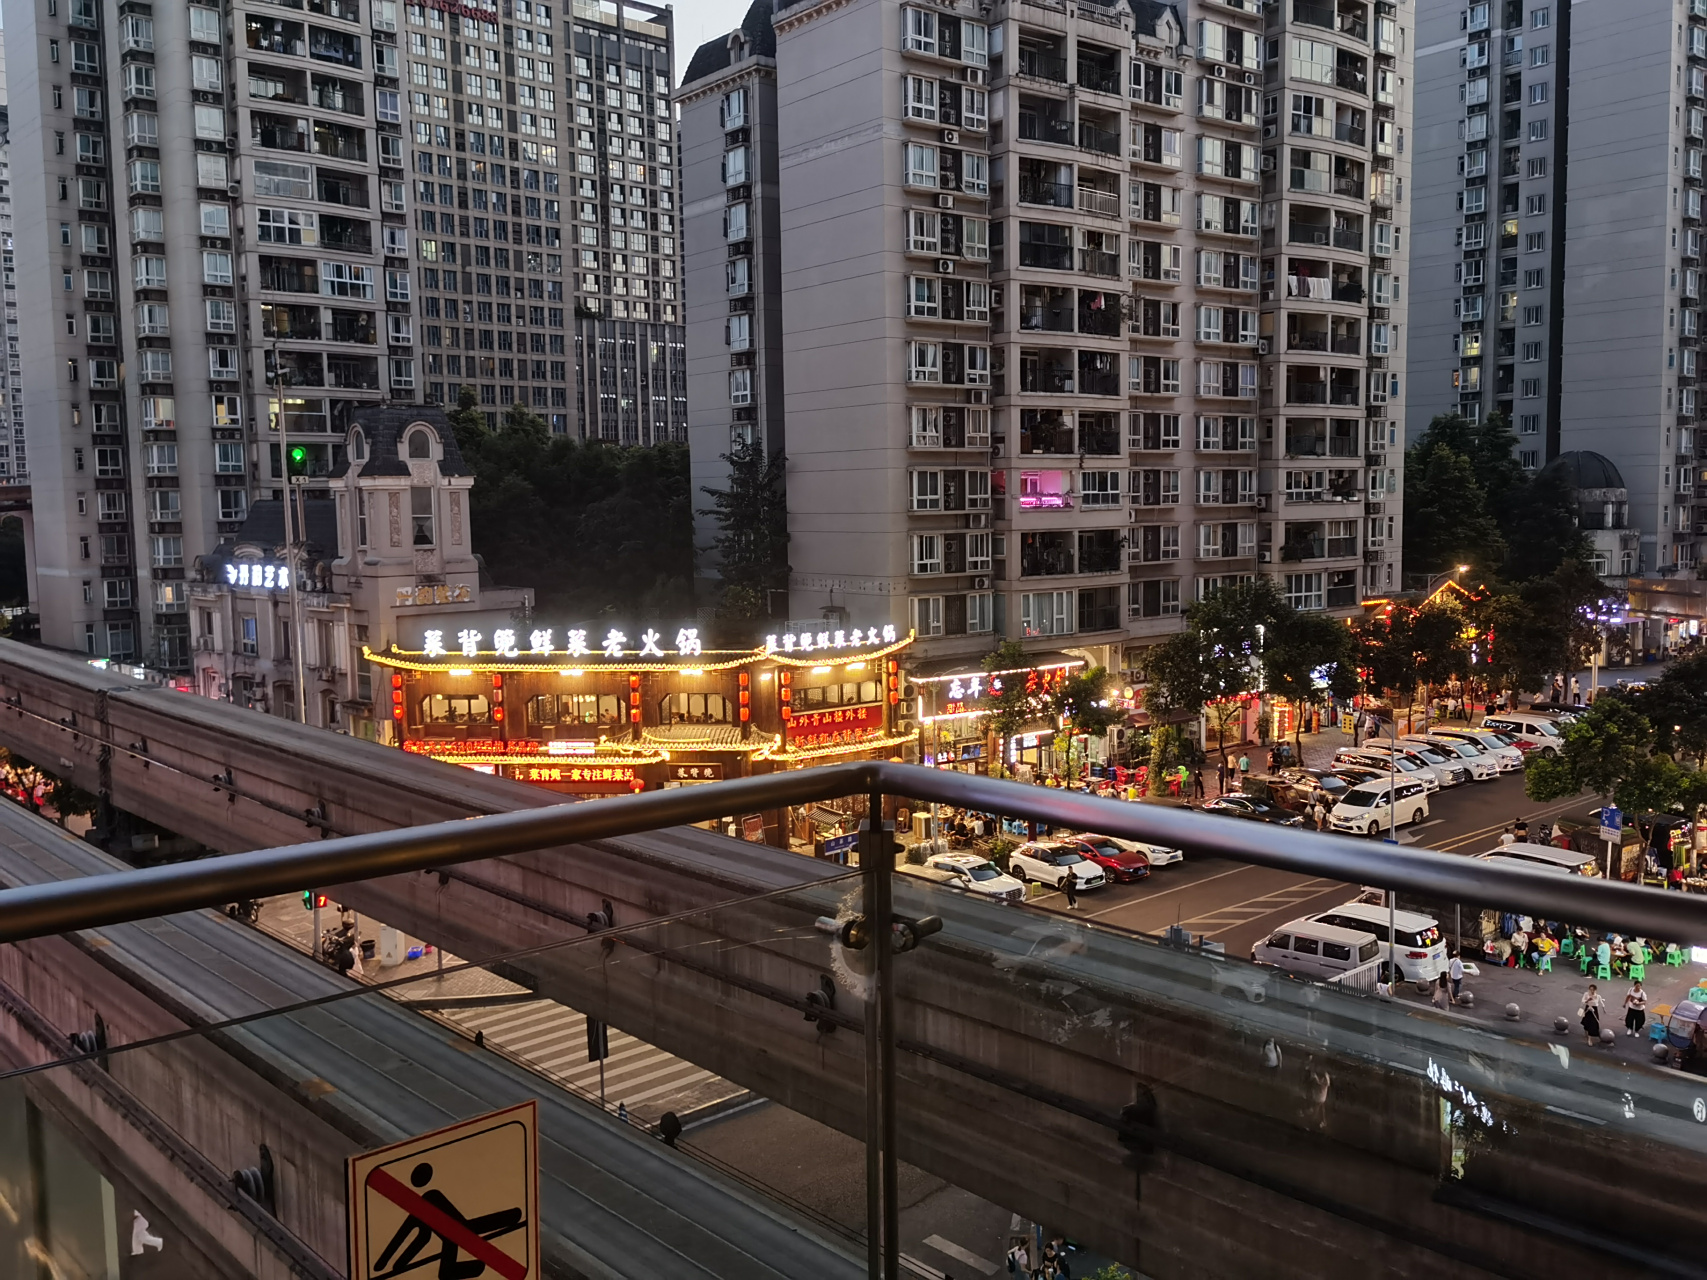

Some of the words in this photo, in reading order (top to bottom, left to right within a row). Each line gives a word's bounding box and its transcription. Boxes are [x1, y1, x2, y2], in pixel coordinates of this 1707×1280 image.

[787, 708, 868, 729] 山外青山楼外楼
